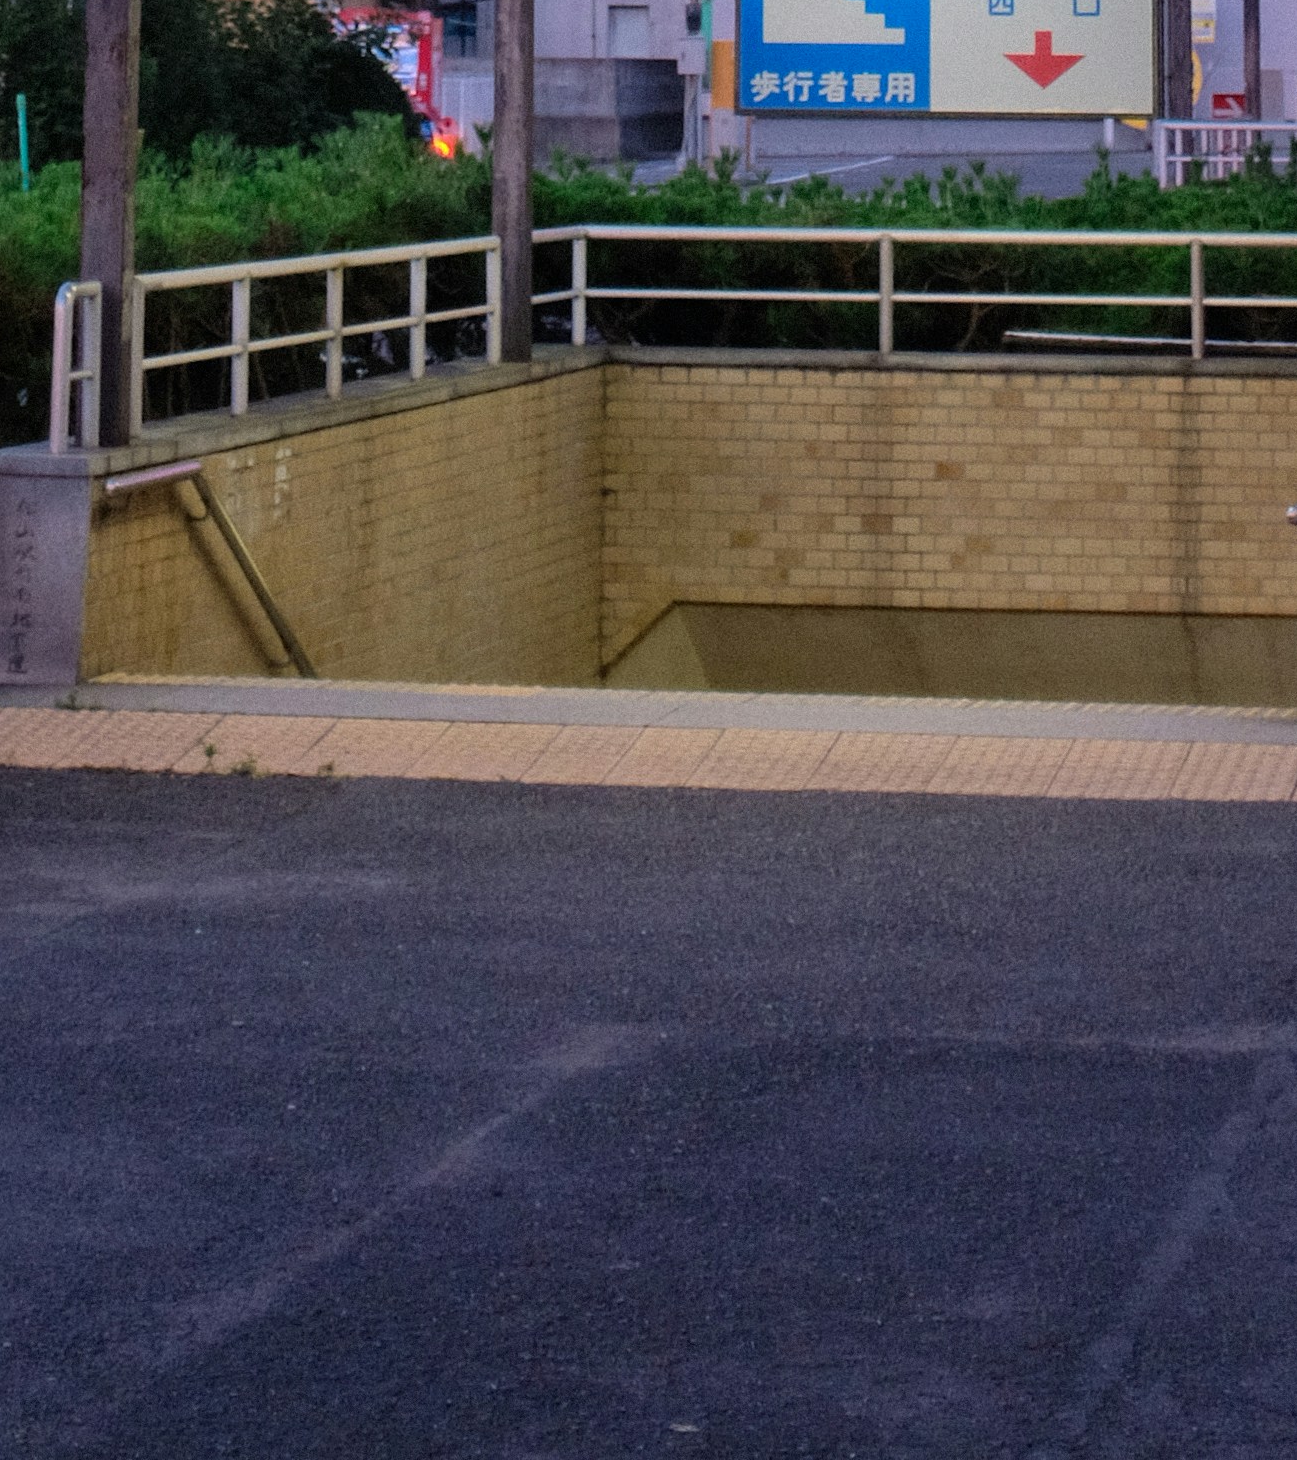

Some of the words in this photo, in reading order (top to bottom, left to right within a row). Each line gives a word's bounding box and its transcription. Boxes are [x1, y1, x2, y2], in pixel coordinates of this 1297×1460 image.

[750, 71, 916, 104] 歩行者専用
